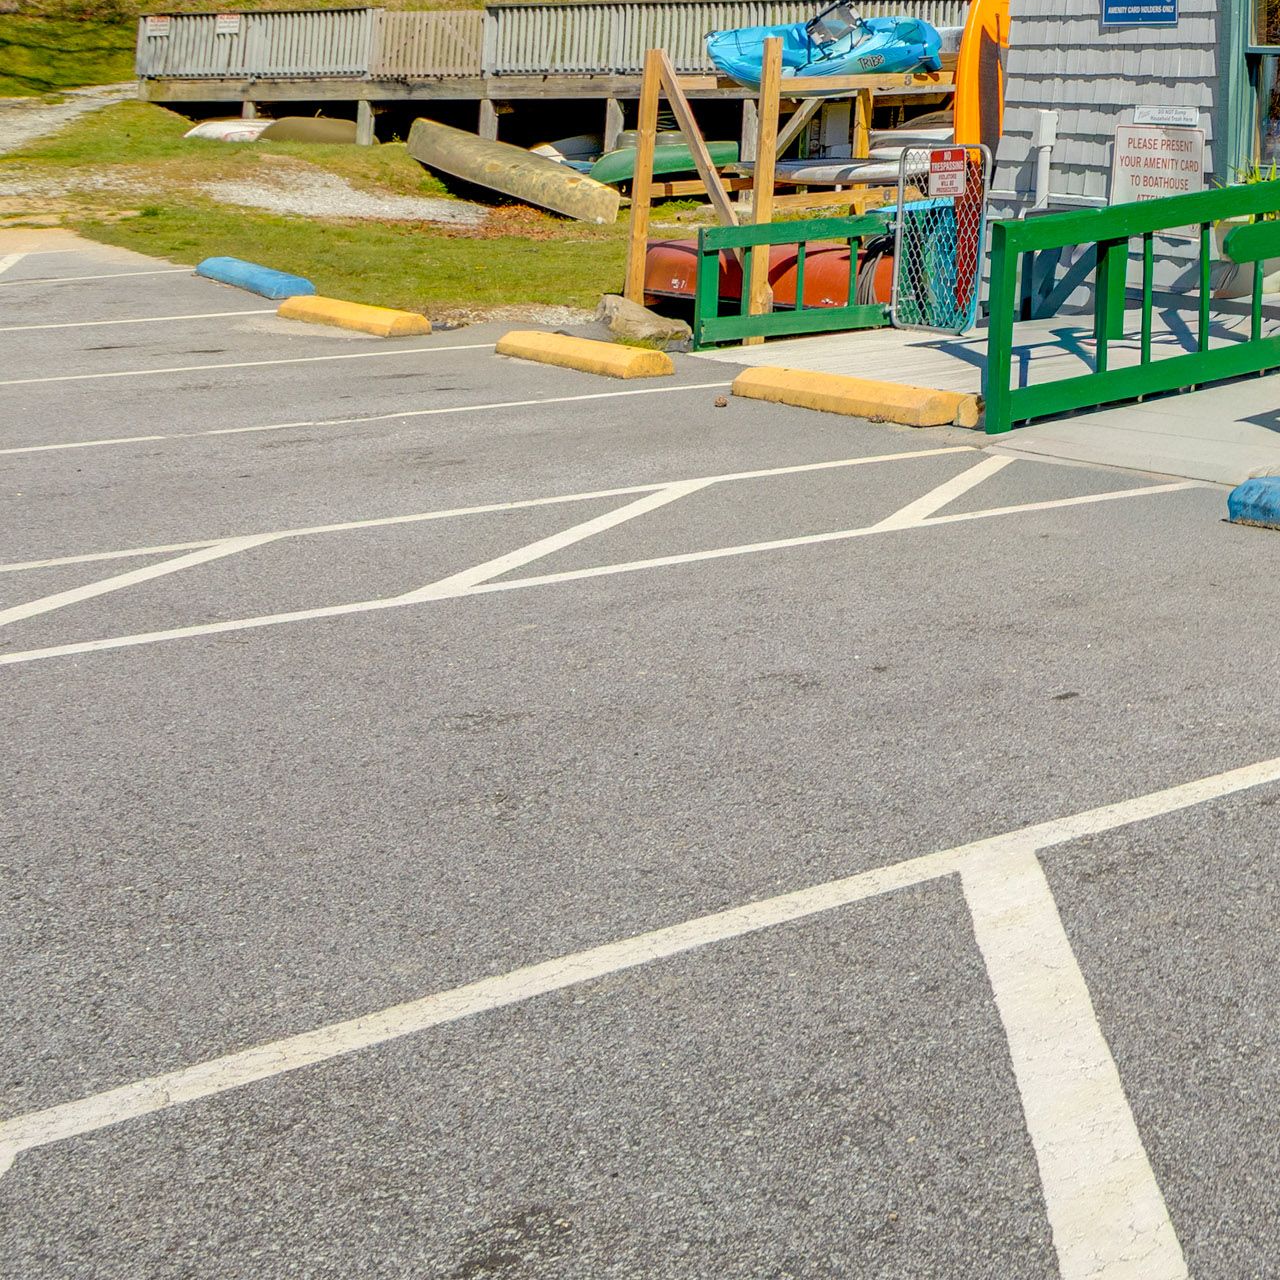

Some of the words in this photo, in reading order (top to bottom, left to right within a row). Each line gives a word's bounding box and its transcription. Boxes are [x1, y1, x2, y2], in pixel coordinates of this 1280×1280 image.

[1127, 137, 1158, 150] PLEASE
[1161, 139, 1193, 153] PRESENT
[1120, 155, 1141, 168] YOUR
[1143, 157, 1179, 171] AMENITY
[1181, 160, 1199, 172] CARD
[1130, 174, 1141, 187] TO
[1143, 175, 1189, 191] BOATHOUSE
